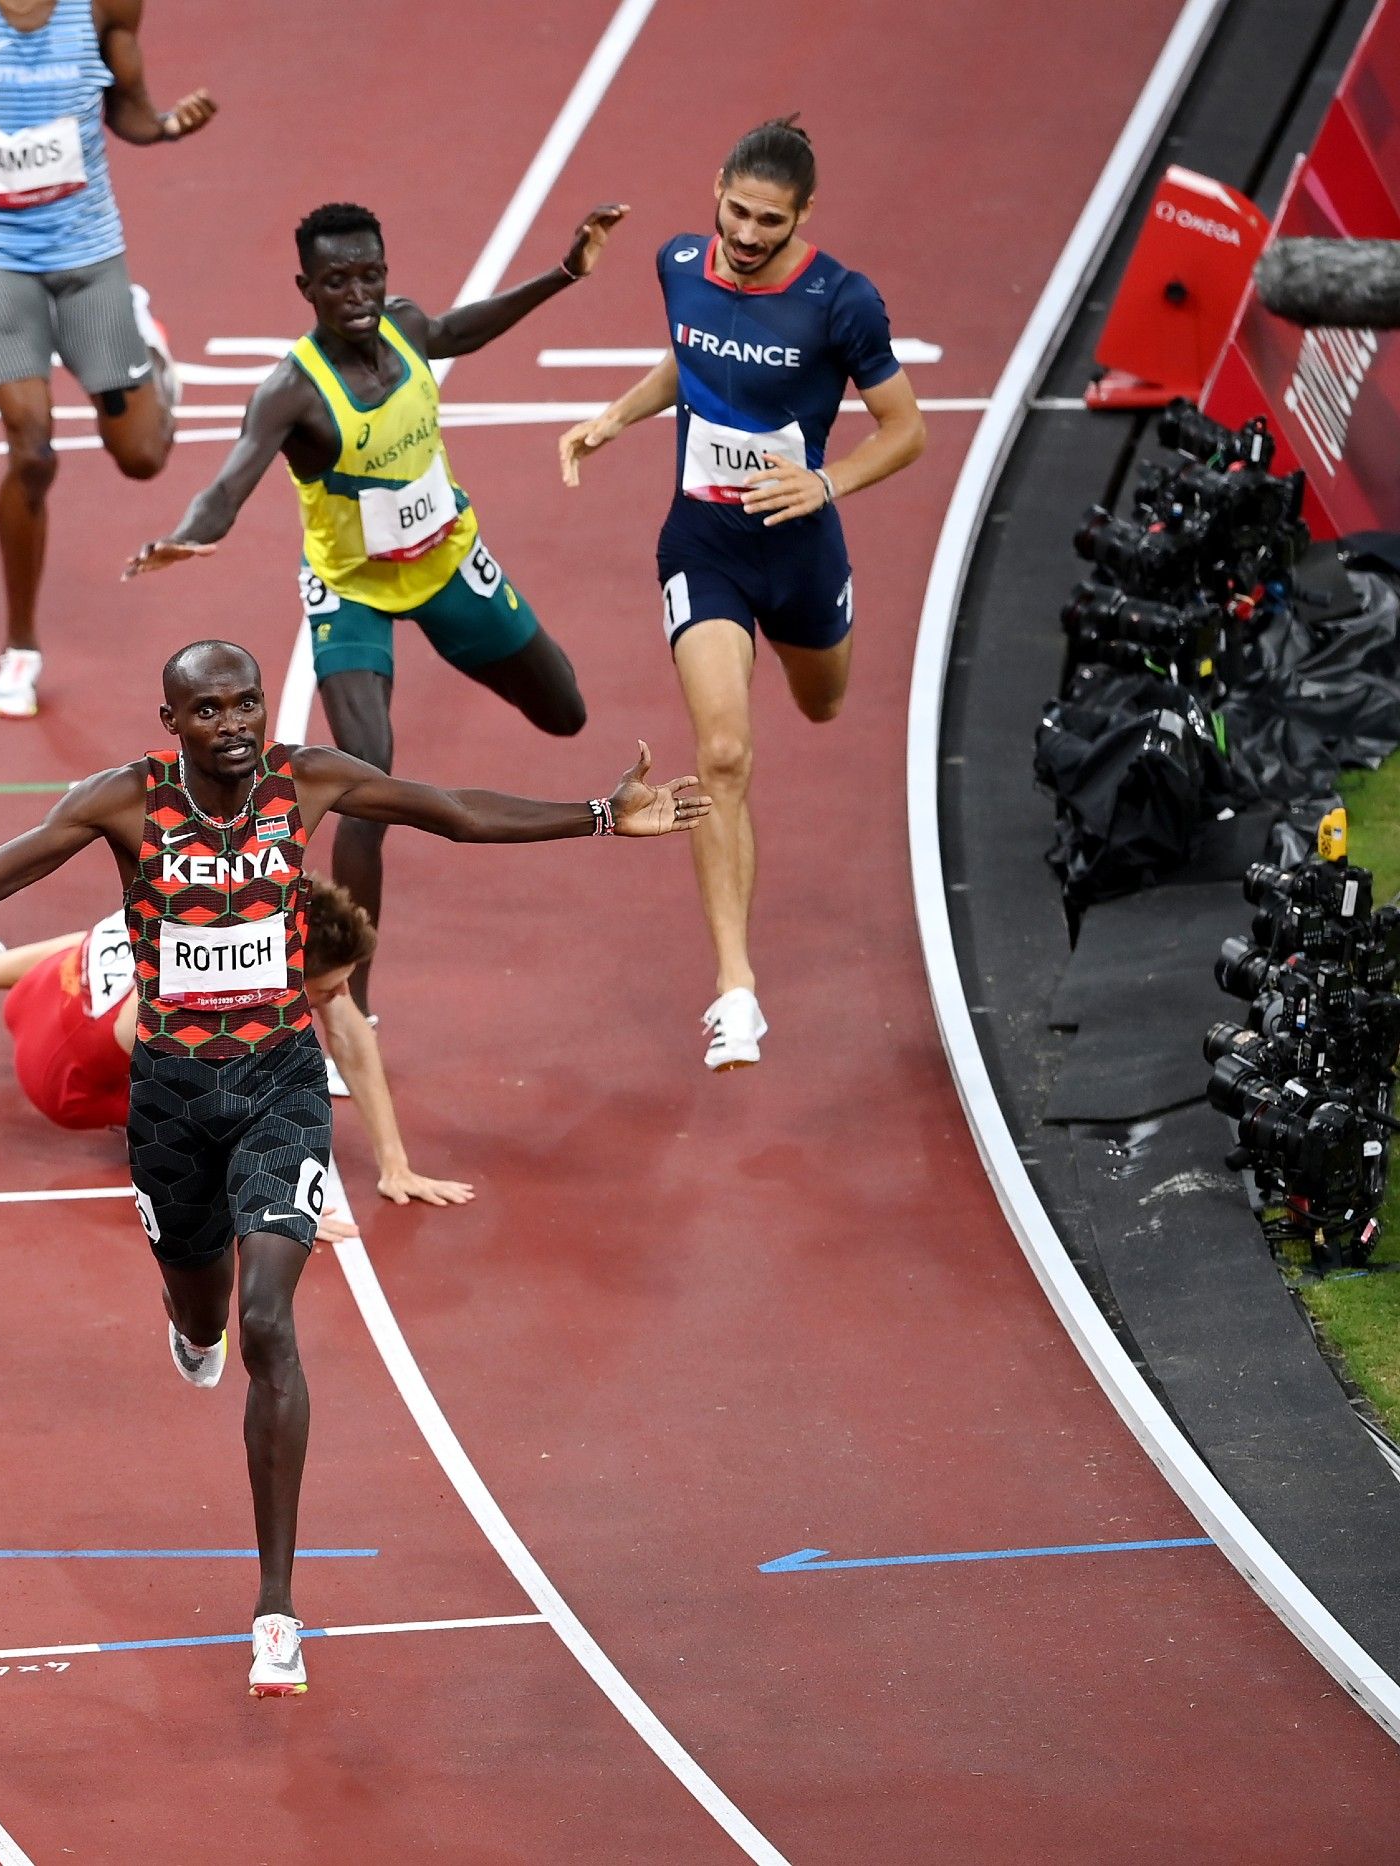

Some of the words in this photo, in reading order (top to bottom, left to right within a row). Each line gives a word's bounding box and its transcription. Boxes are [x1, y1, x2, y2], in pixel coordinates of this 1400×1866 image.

[1175, 209, 1241, 247] OMEGA
[688, 327, 801, 368] FRANCE
[400, 493, 436, 529] BOL
[472, 549, 497, 585] 8
[307, 575, 327, 606] 8
[161, 846, 290, 885] KENYA
[175, 936, 272, 972] ROTICH
[306, 1169, 324, 1216] 6
